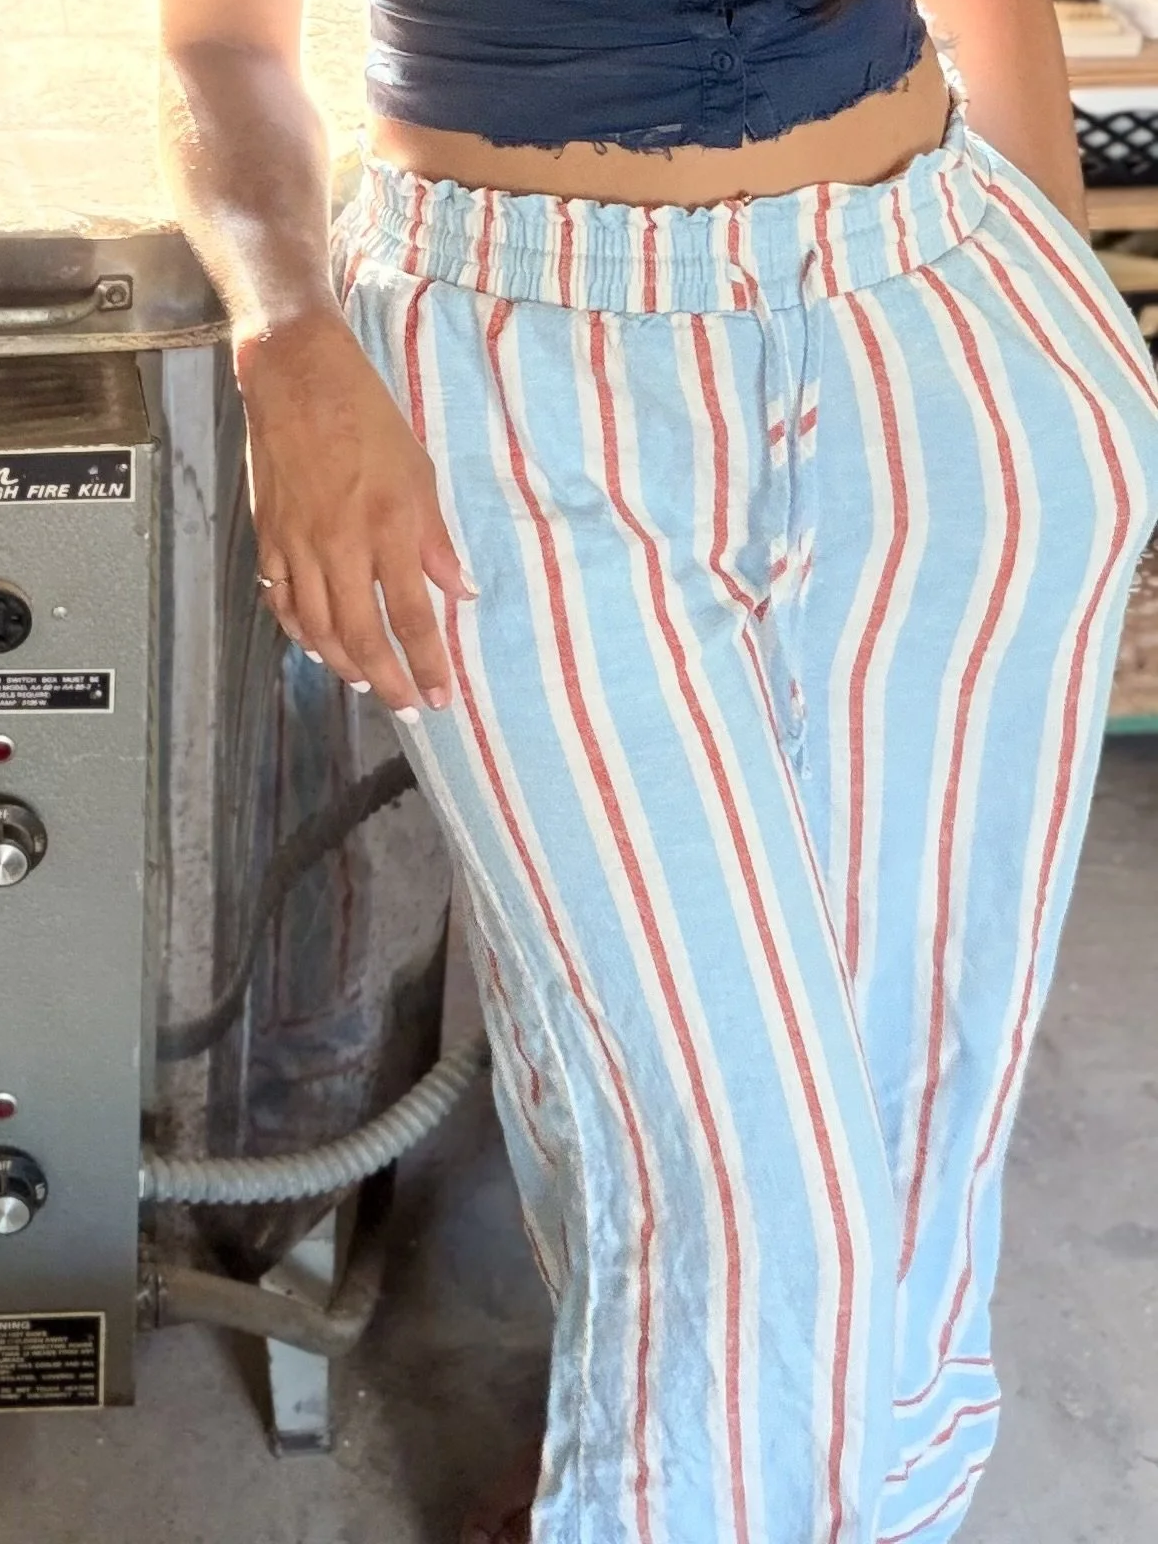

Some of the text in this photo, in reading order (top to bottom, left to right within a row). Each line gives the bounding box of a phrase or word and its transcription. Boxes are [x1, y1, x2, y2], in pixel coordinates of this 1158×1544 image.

[26, 484, 71, 499] FIRE
[77, 483, 124, 497] KILN
[6, 676, 37, 684] SWITCH
